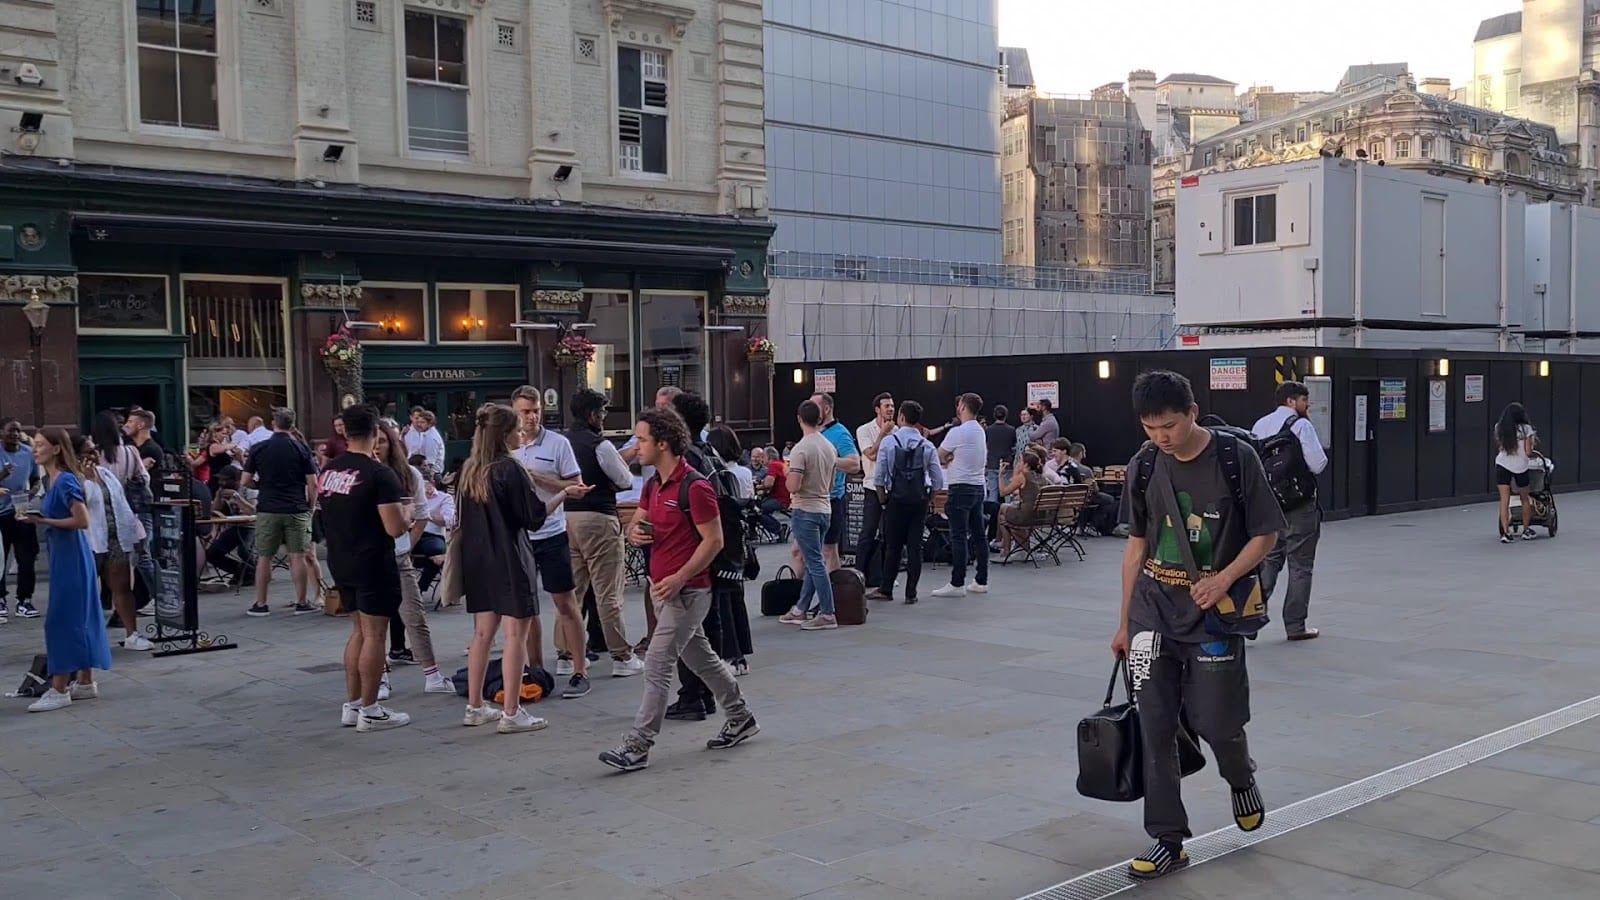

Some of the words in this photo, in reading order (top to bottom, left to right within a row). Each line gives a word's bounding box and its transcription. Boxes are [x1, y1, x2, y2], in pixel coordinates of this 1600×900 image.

[1211, 367, 1247, 375] DANGER
[1133, 650, 1143, 691] NORTH
[1142, 650, 1152, 680] FACE
